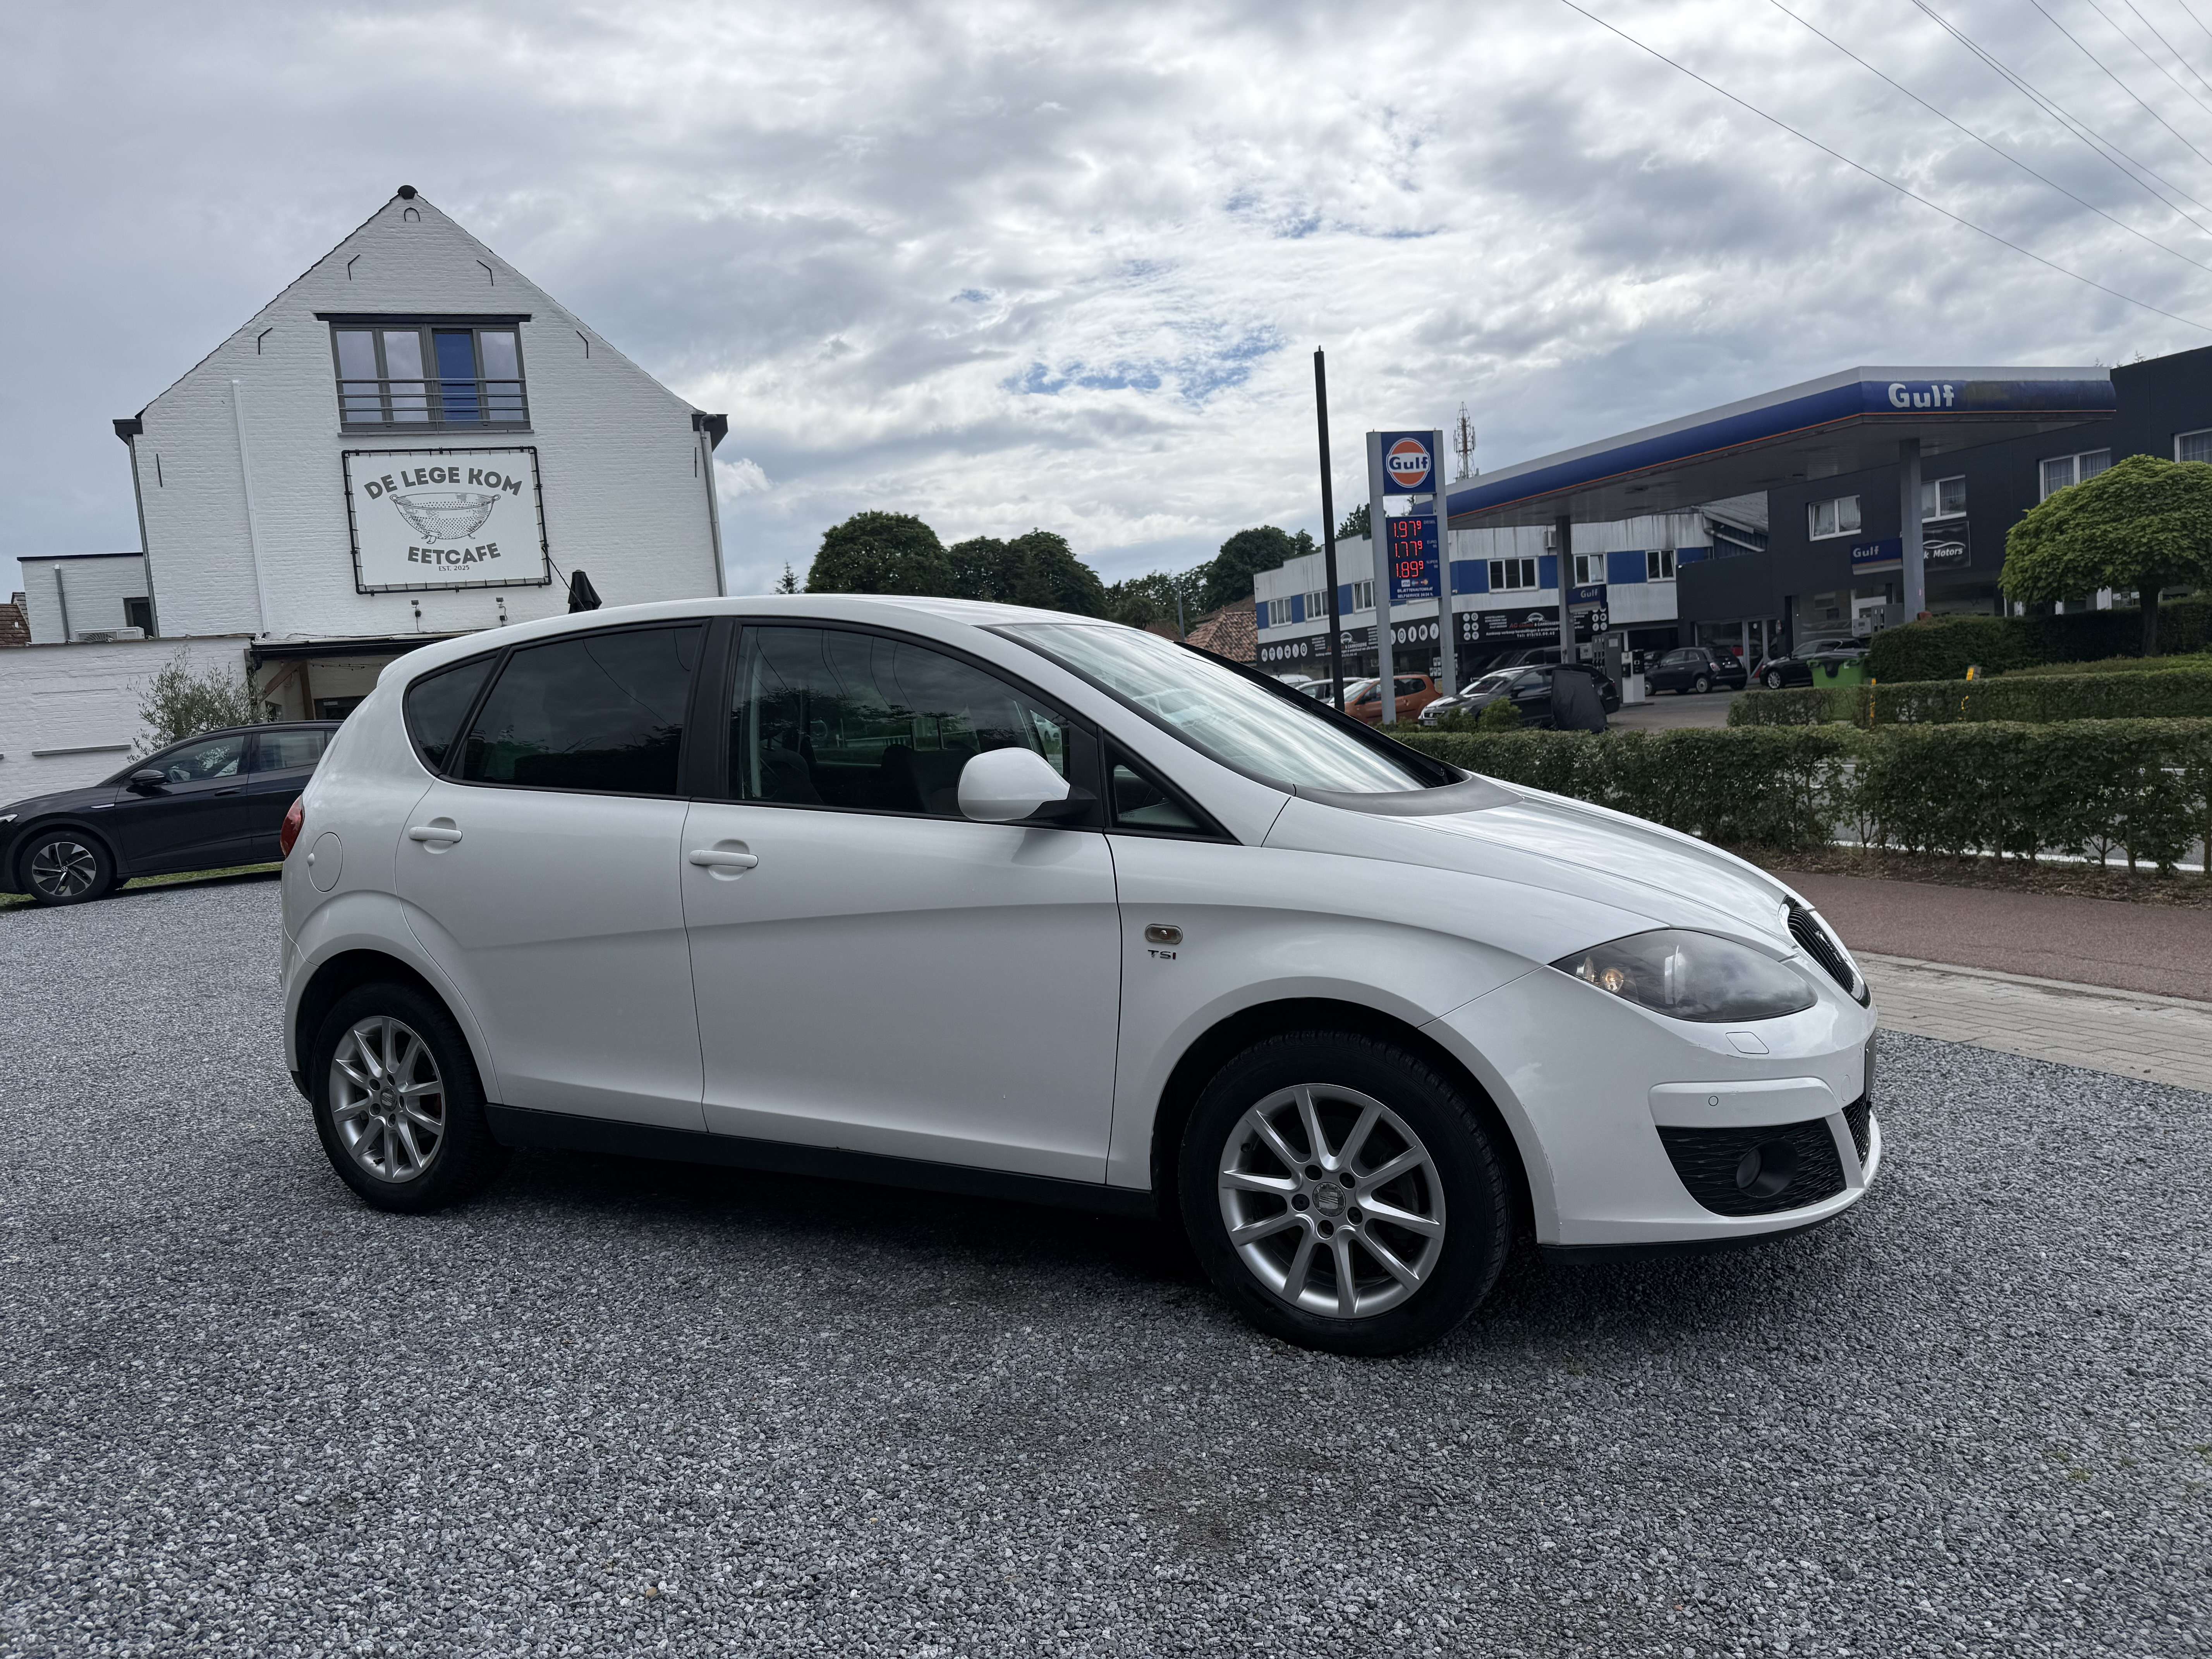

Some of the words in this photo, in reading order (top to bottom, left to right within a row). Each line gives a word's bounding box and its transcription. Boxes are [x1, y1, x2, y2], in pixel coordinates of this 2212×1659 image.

[1888, 383, 1954, 408] Gulf
[1389, 456, 1428, 470] Gulf
[364, 474, 397, 500] DE
[401, 467, 460, 487] LEGE
[468, 468, 522, 496] KOM
[407, 543, 501, 565] EETCAFE
[1853, 545, 1879, 558] Gulf
[1933, 548, 1963, 558] Motors
[1580, 589, 1598, 598] Gulf
[1147, 949, 1176, 960] TSI
